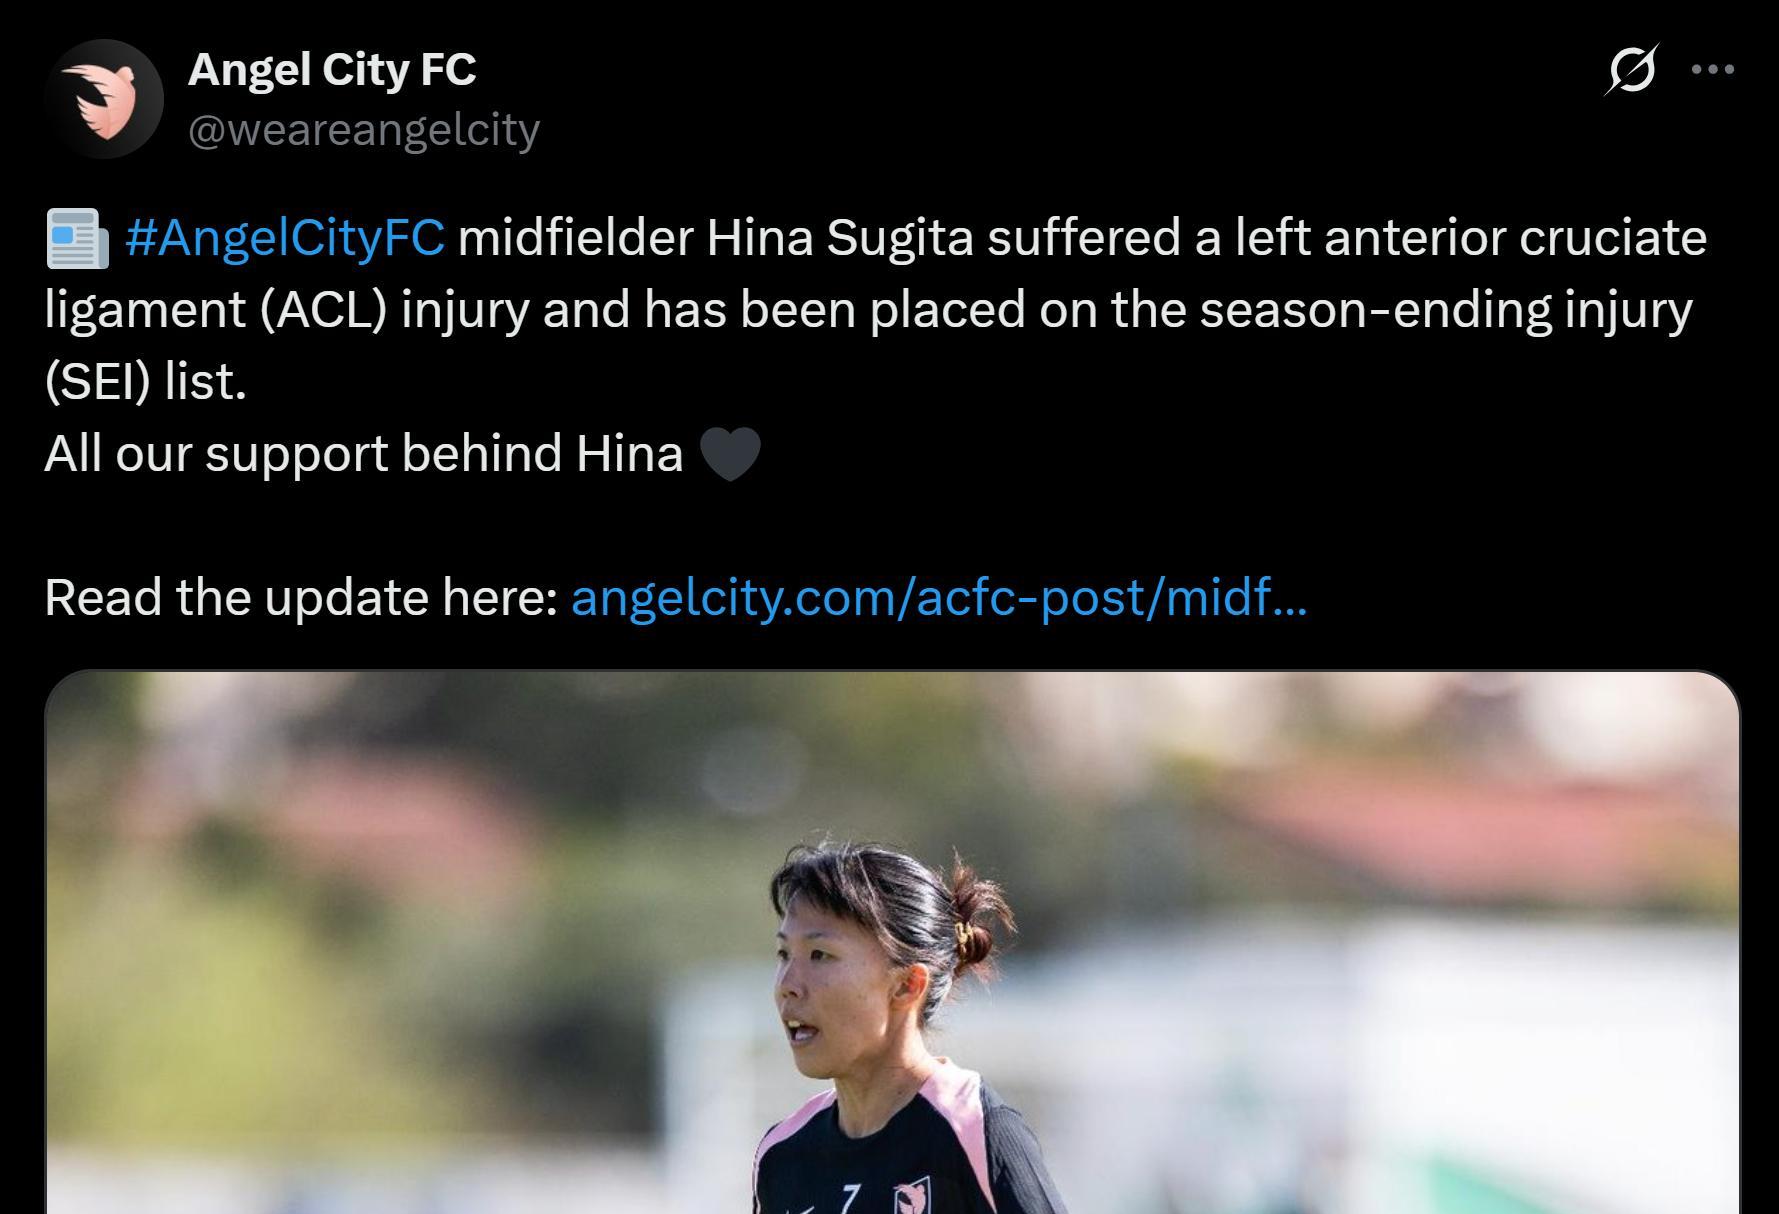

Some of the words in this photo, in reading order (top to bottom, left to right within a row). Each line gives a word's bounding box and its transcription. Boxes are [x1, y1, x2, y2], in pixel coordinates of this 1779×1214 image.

[187, 50, 311, 95] Angel
[322, 49, 411, 95] City
[422, 52, 477, 86] FC
[189, 110, 541, 155] @weareangelcity
[125, 215, 446, 267] #AngelCityFC
[459, 215, 695, 256] midfielder
[709, 215, 813, 256] Hina
[827, 215, 974, 266] Sugita
[987, 215, 1180, 256] suffered
[1195, 227, 1221, 256] a
[1237, 215, 1312, 256] left
[1325, 215, 1508, 256] anterior
[1520, 215, 1708, 256] cruciate
[46, 287, 247, 338] ligament
[260, 286, 387, 335] (ACL)
[402, 287, 531, 338] injury
[543, 287, 629, 328] and
[646, 287, 727, 328] has
[742, 287, 855, 328] been
[871, 287, 1025, 338] placed
[1040, 299, 1097, 328] on
[1110, 287, 1187, 328] the
[1200, 287, 1554, 338] season-ending
[1565, 287, 1694, 338] injury
[46, 358, 150, 407] (SEI)
[166, 359, 246, 400] list.
[43, 431, 101, 472] All
[116, 443, 194, 472] our
[205, 435, 389, 482] support
[403, 431, 561, 472] behind
[578, 431, 683, 472] Hina
[46, 575, 161, 616] Read
[175, 575, 252, 616] the
[266, 575, 429, 626] update
[444, 575, 557, 616] here:
